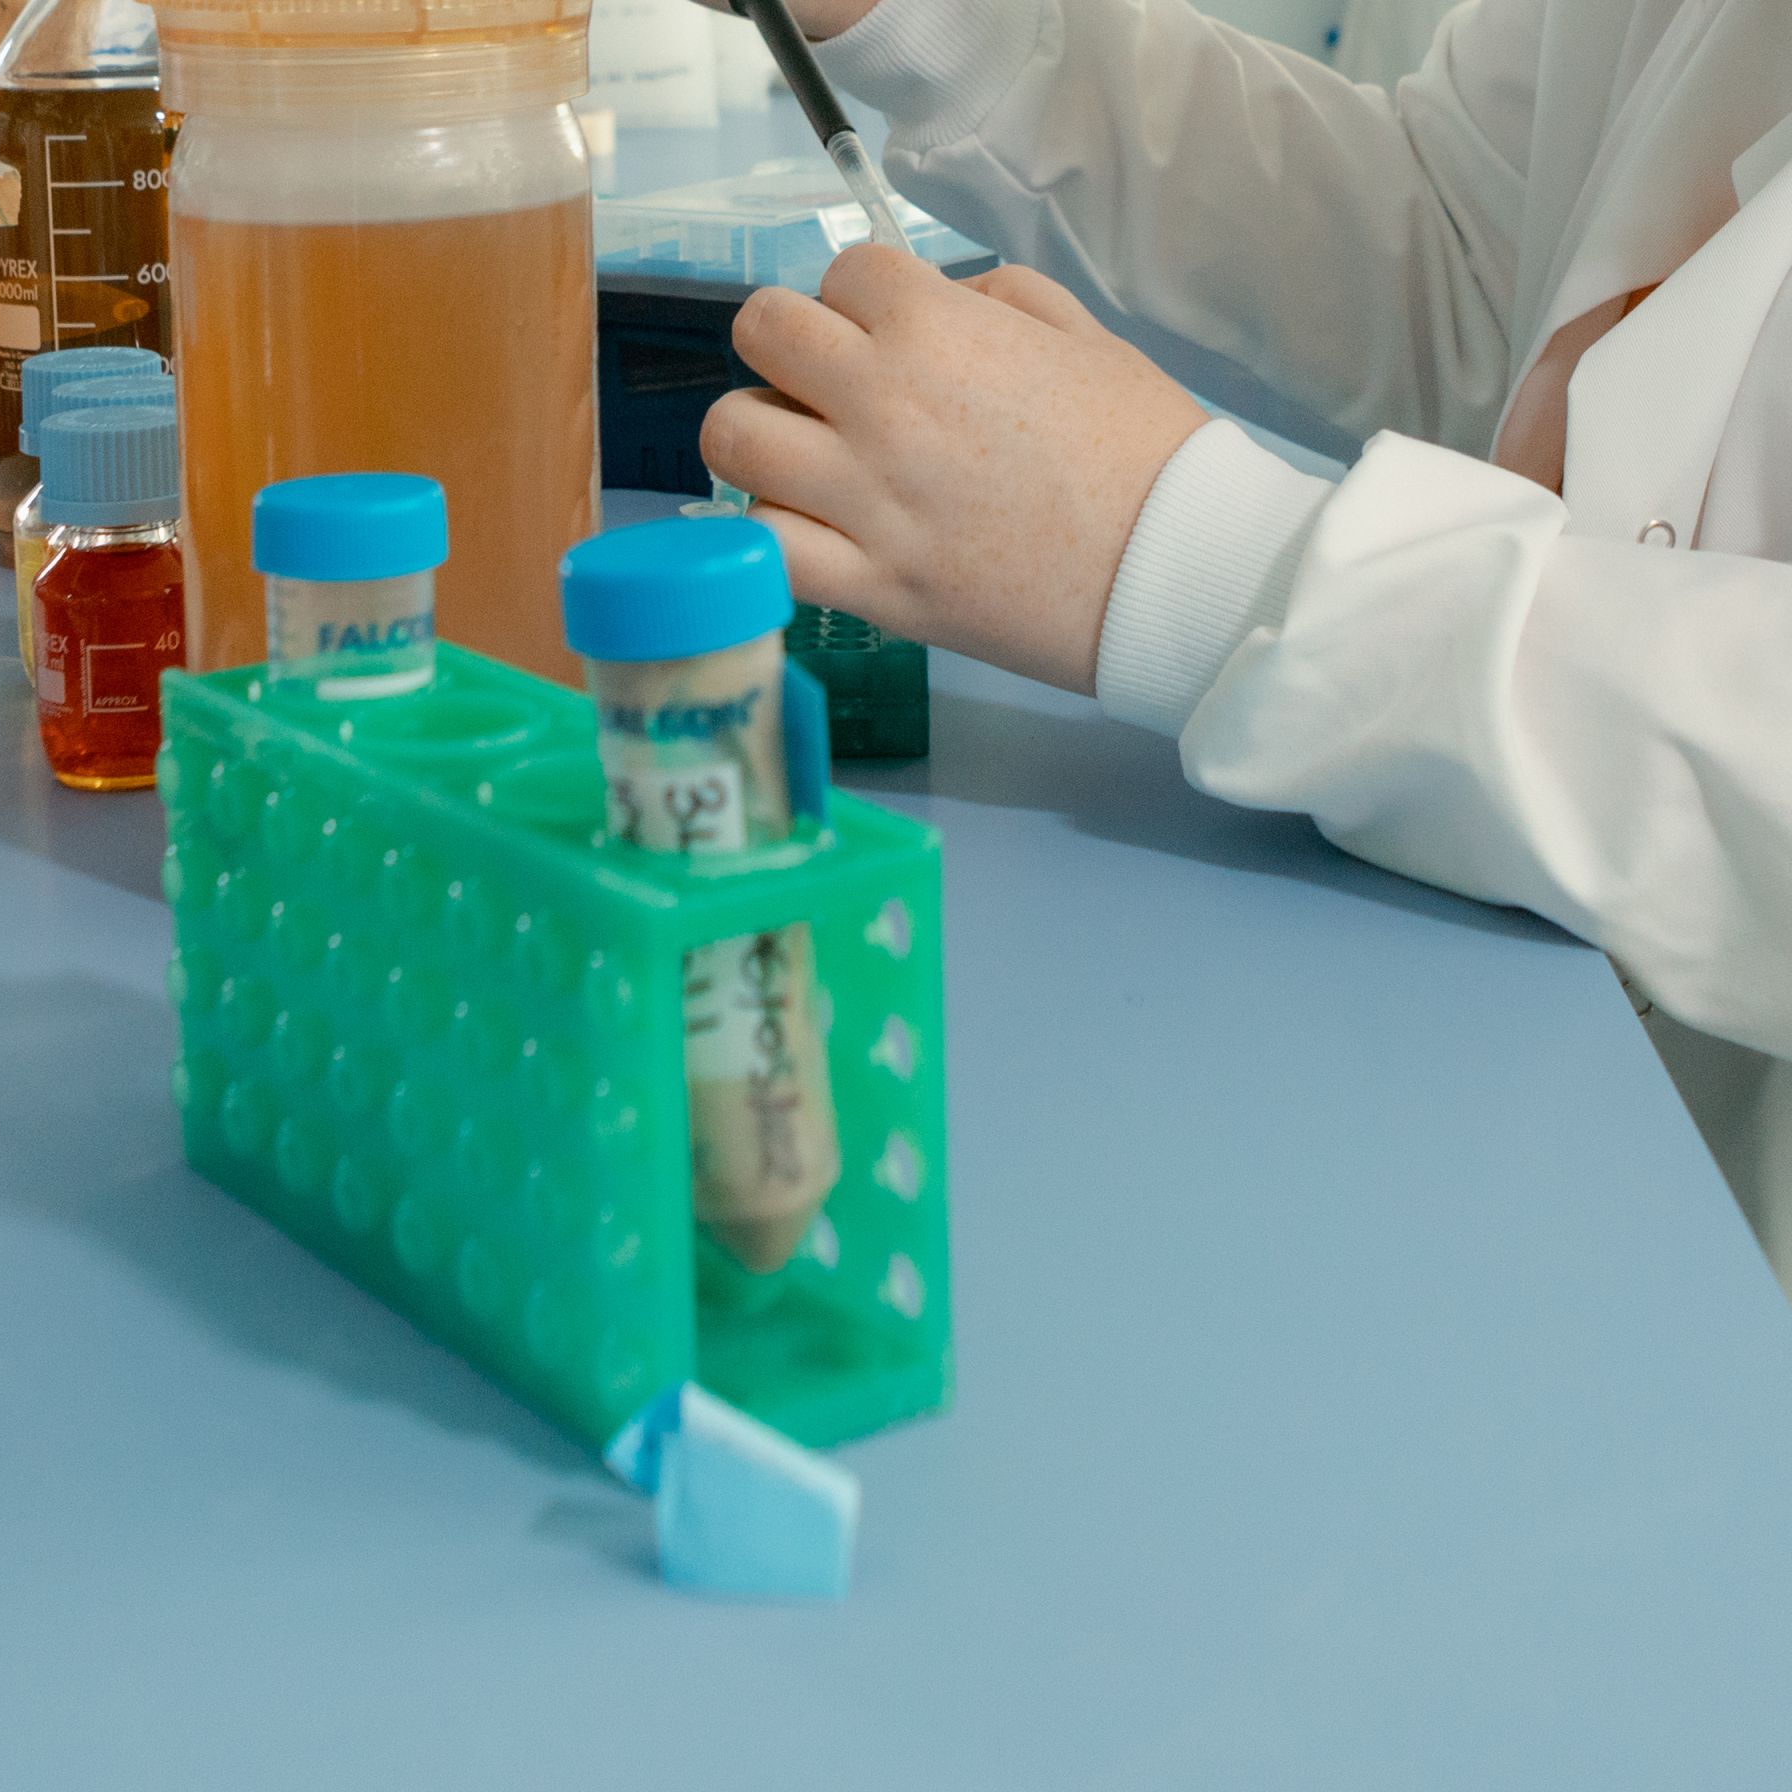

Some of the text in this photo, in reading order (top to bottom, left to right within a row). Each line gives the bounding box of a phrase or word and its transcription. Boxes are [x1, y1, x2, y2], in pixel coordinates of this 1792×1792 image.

[136, 263, 171, 285] 60
[153, 630, 181, 652] 40
[94, 695, 139, 707] APPROX
